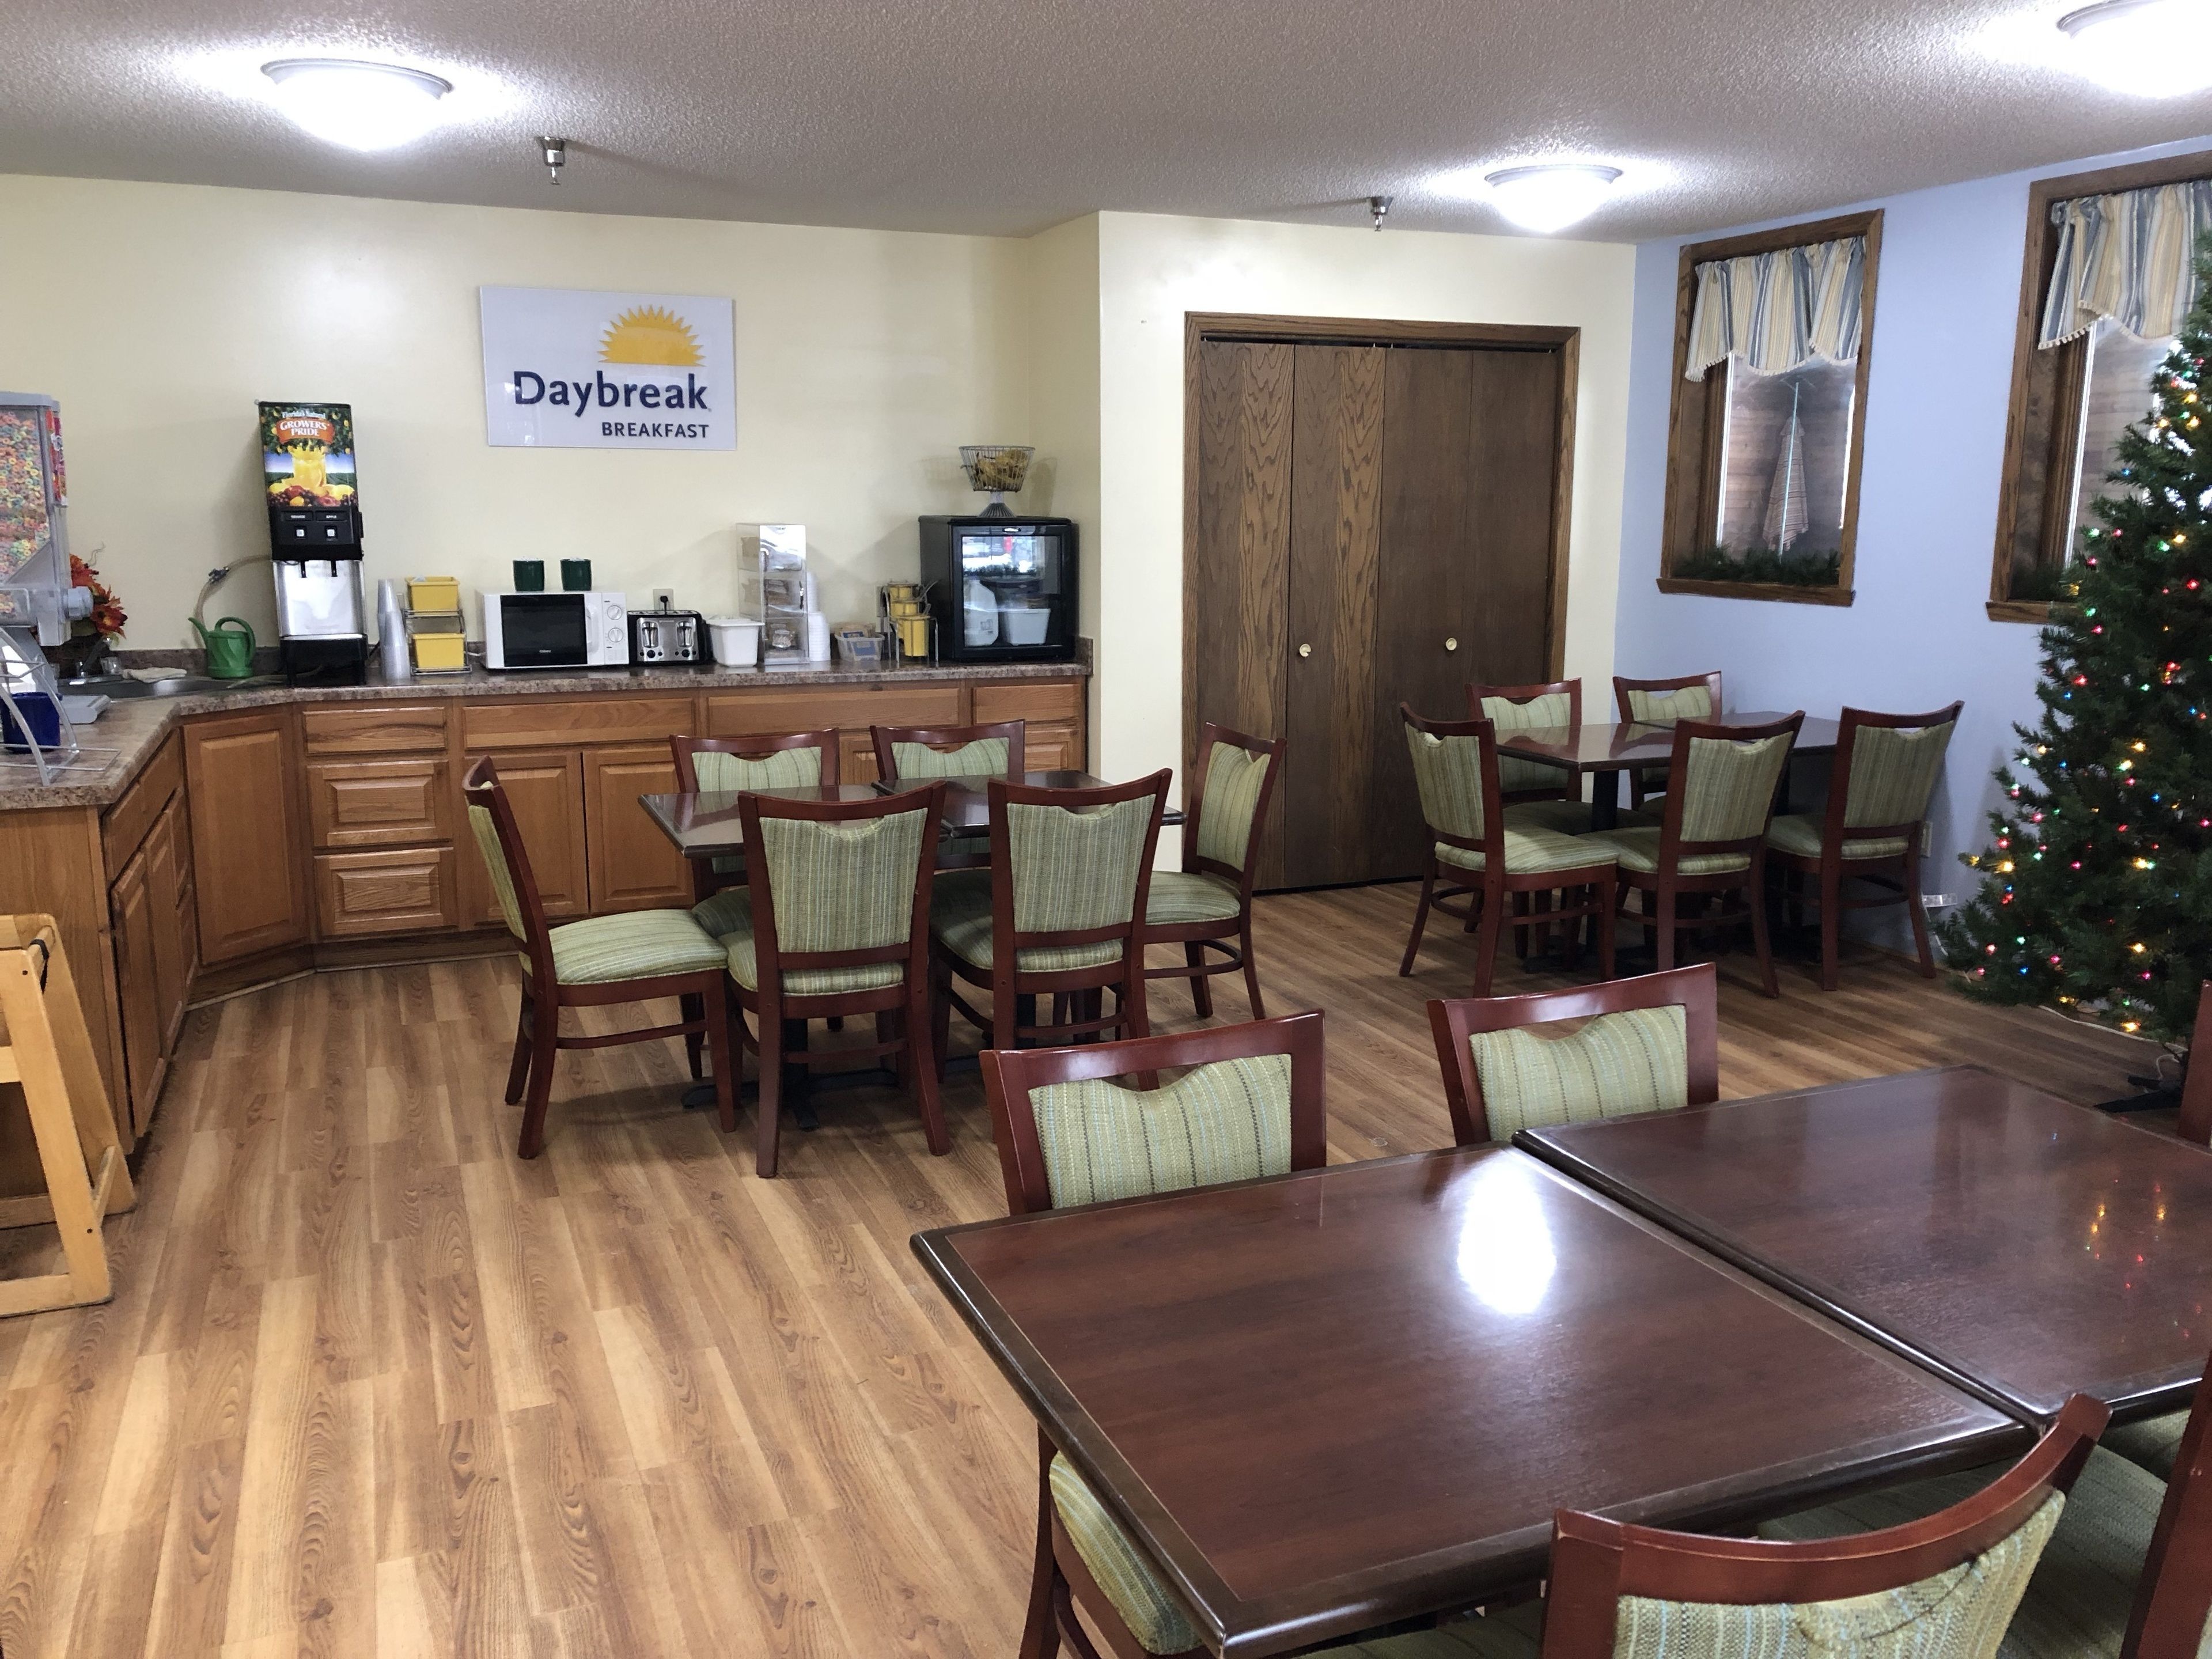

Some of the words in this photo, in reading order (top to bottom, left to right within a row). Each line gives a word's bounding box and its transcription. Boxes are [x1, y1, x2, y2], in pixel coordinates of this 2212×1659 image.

[513, 370, 709, 417] Daybreak
[291, 428, 319, 436] PRIDE
[601, 422, 709, 438] BREAKFAST
